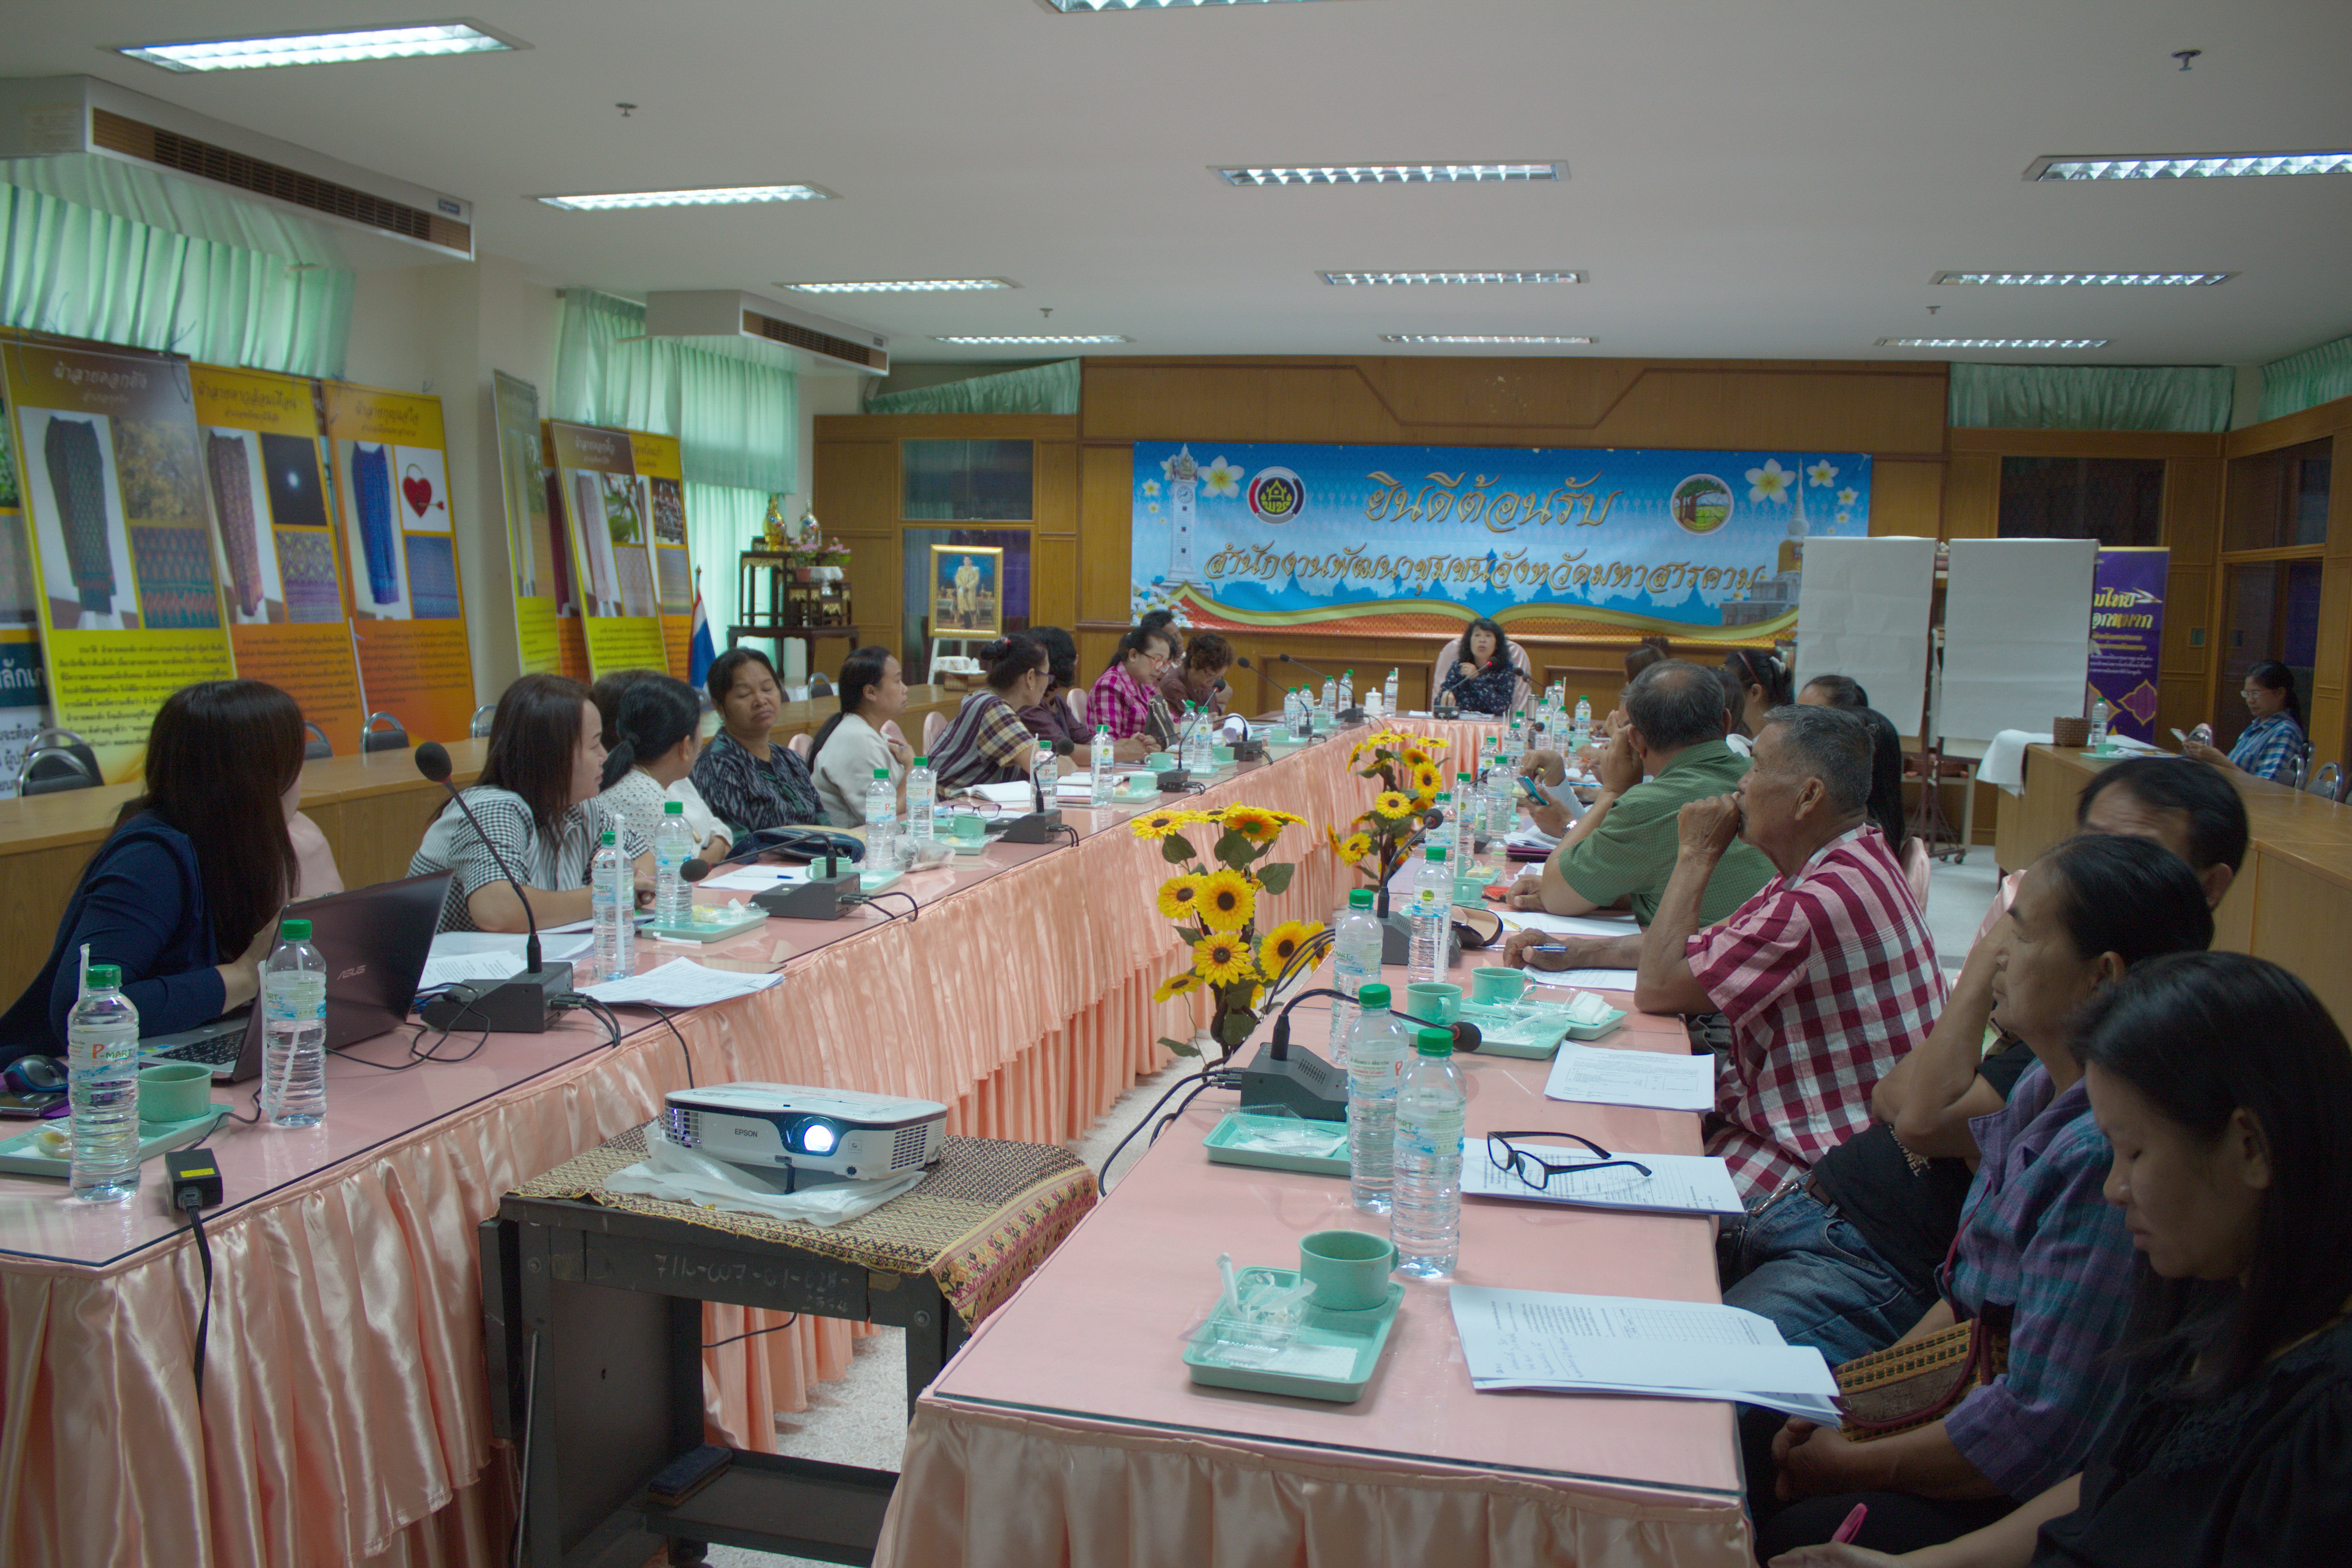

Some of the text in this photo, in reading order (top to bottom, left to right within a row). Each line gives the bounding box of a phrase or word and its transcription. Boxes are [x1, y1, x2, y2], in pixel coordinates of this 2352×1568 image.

[1363, 470, 1624, 533] ยินดีต้อนรับ
[1204, 539, 1766, 596] สำนักงานพัฒนาชุมชนจังหวัดมหาสารคาม
[337, 965, 366, 980] ASUS
[91, 1044, 132, 1059] P-MART
[735, 1128, 758, 1137] EPSON
